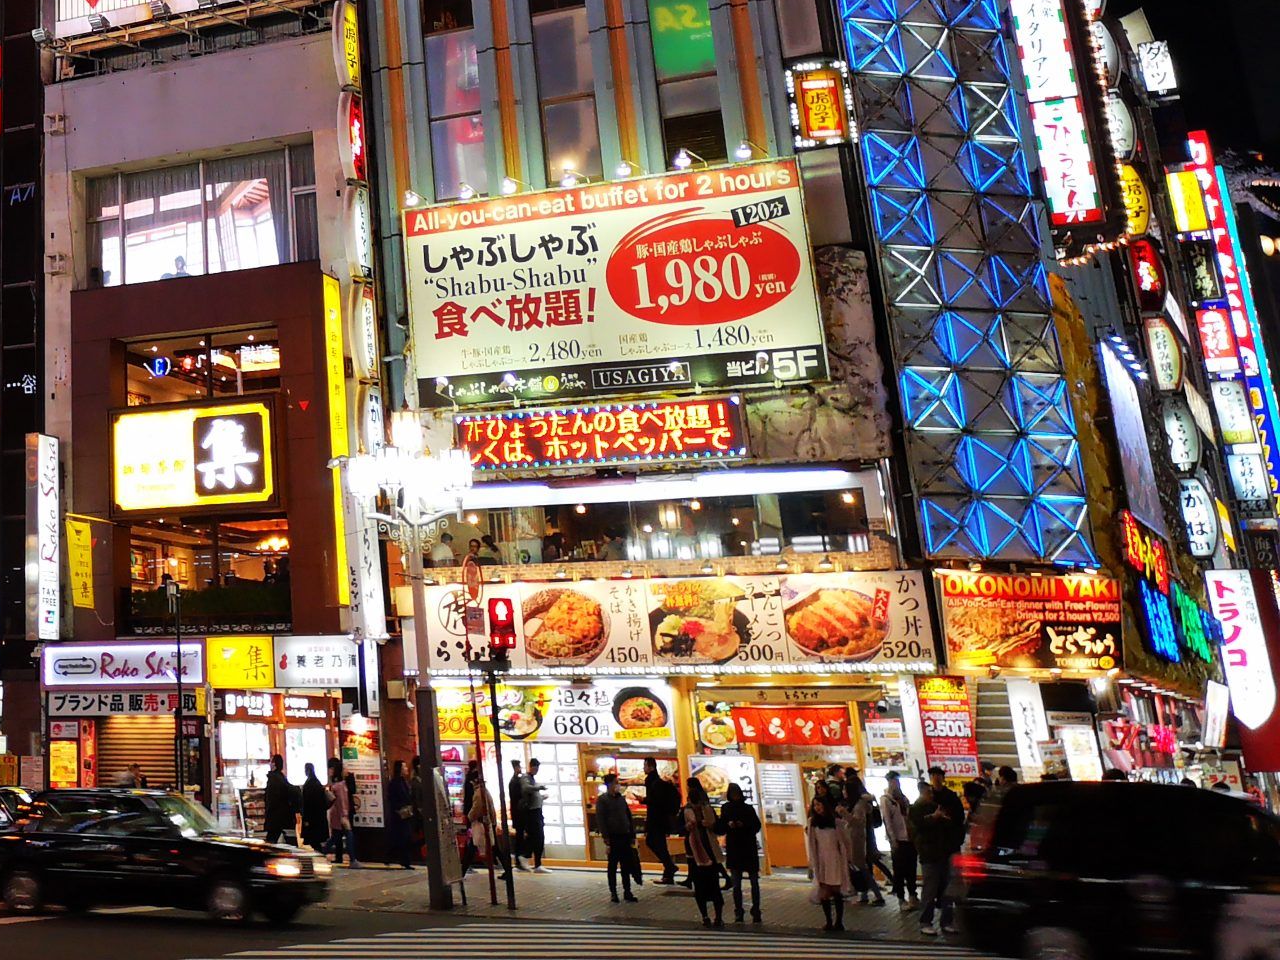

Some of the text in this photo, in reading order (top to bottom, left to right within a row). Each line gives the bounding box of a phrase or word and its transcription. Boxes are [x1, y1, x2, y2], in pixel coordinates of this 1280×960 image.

[1027, 3, 1049, 88] イタリアン
[413, 169, 791, 232] All-you-can-eat buffet for 2 hours
[734, 199, 784, 225] 120分
[422, 224, 599, 274] しゃぶしゃぶ
[636, 232, 762, 257] 豚・国産鶏しゃぶしゃぶ
[633, 253, 751, 315] 1,980
[756, 278, 786, 297] yen
[432, 287, 597, 339] 食べ放題!
[599, 367, 686, 386] USAGIYA
[726, 350, 818, 378] 当ビル 5F
[196, 419, 259, 489] 集
[609, 586, 622, 613] そば
[945, 575, 1118, 599] OKONOMI YAKI
[625, 586, 642, 641] かき揚げ
[745, 582, 759, 641] ラーメン
[763, 582, 781, 641] とんこつ
[897, 575, 923, 637] かつ丼
[1017, 600, 1043, 610] dinner
[1045, 601, 1063, 609] with
[1065, 601, 1119, 612] Free-Flowing
[1017, 611, 1043, 620] Drinks
[1045, 612, 1056, 620] for
[1067, 612, 1091, 621] hours
[243, 644, 270, 681] 集
[606, 646, 648, 664] 450円
[738, 645, 784, 662] 500円
[882, 641, 932, 659] 520円
[99, 651, 139, 679] Roko
[54, 693, 198, 713] ブランド品 販売・買取
[553, 716, 610, 736] 680円
